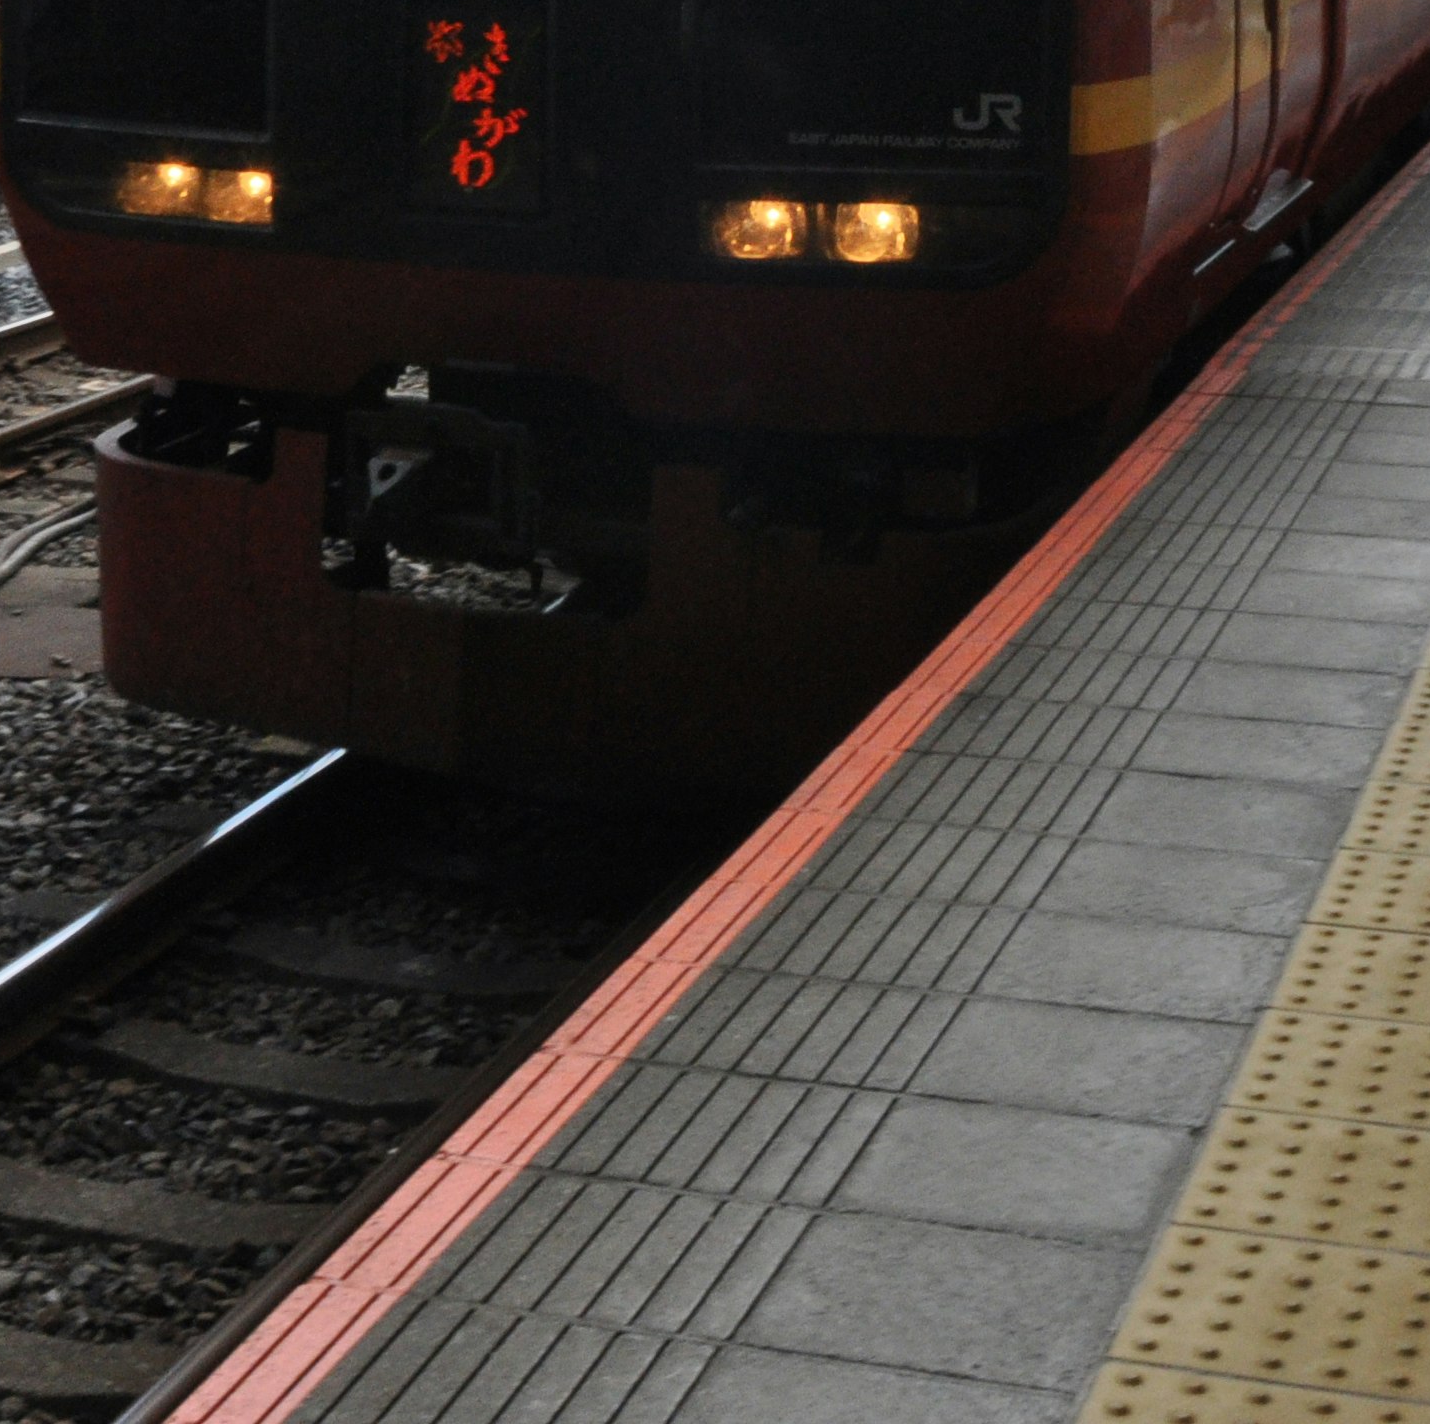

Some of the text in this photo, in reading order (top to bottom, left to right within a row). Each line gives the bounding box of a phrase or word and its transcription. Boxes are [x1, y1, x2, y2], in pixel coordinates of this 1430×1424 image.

[452, 22, 529, 188] きぬがわ
[953, 93, 1023, 132] JR
[788, 132, 1020, 151] EAST JAPAN RAILWAY COMPANY
